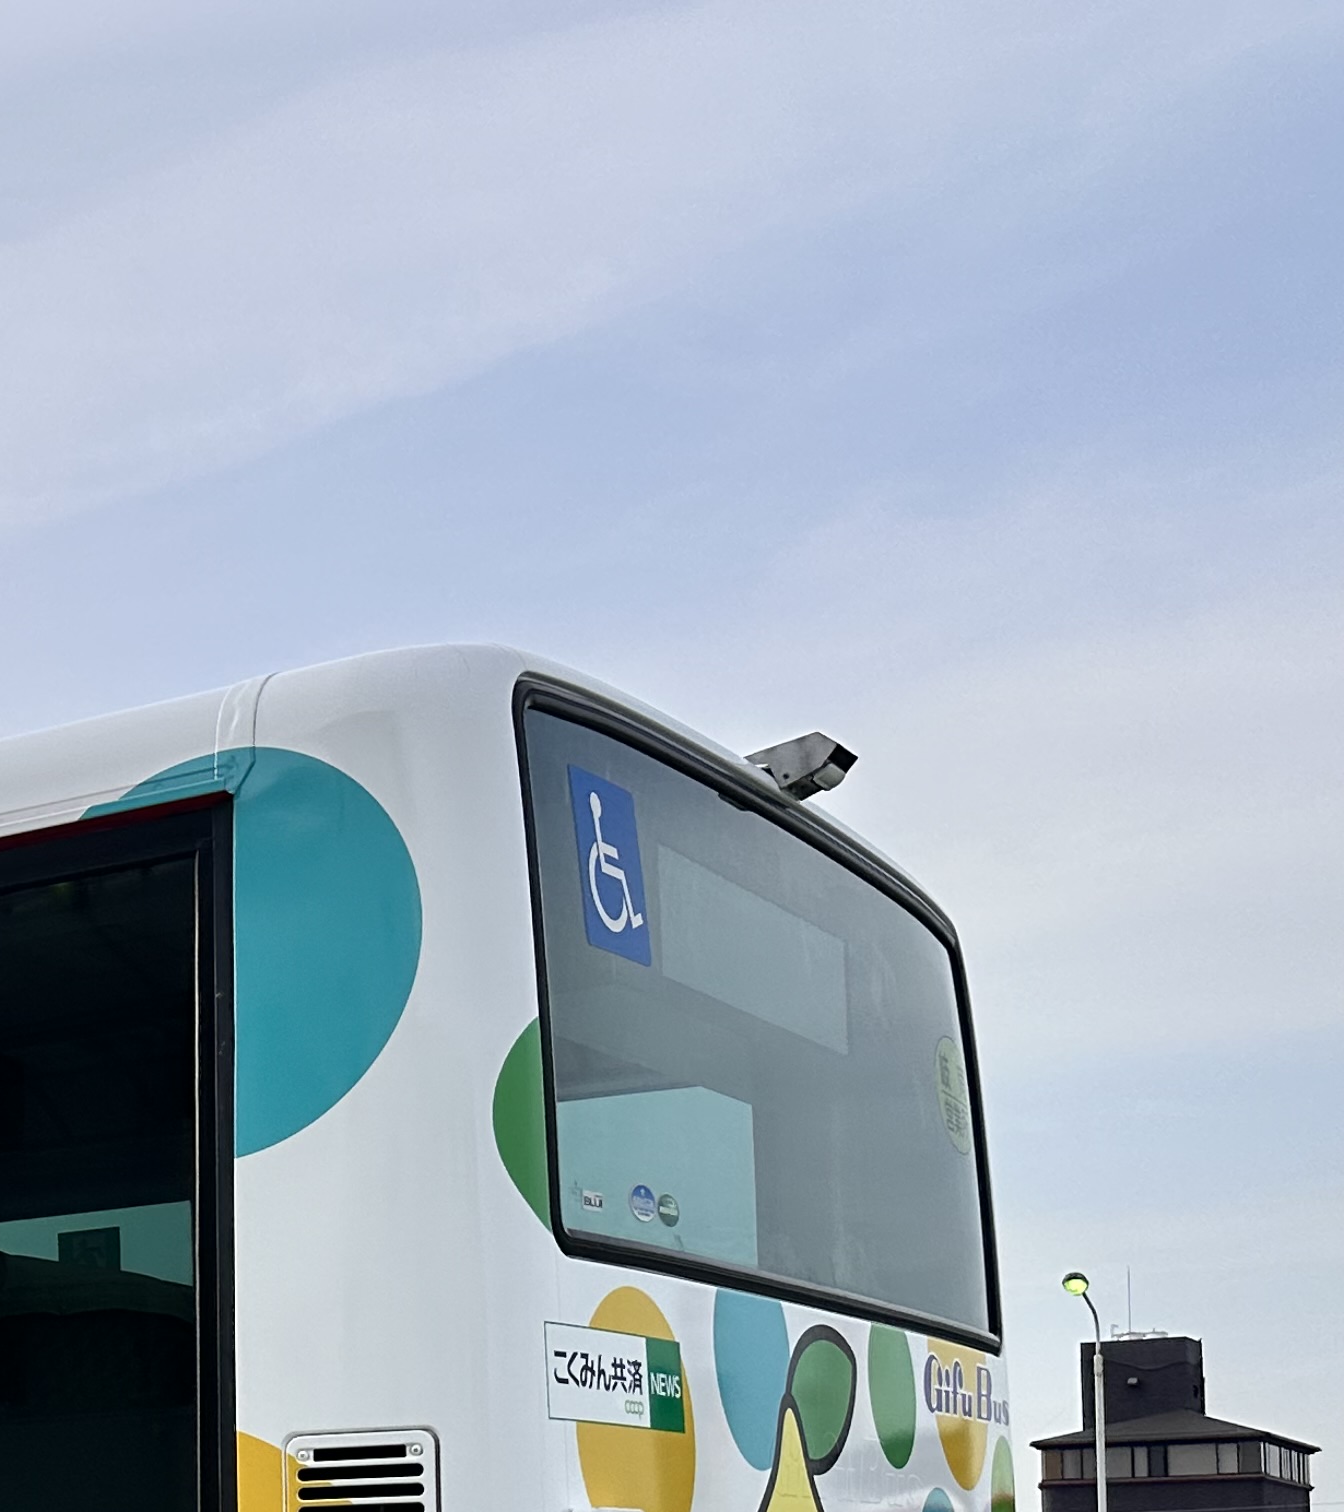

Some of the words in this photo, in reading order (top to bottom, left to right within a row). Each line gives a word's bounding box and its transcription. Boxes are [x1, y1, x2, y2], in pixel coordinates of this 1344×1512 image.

[553, 1349, 644, 1396] こくみん共済
[650, 1371, 682, 1399] NEWS
[923, 1353, 974, 1418] Gifu
[975, 1365, 1010, 1427] Bus
